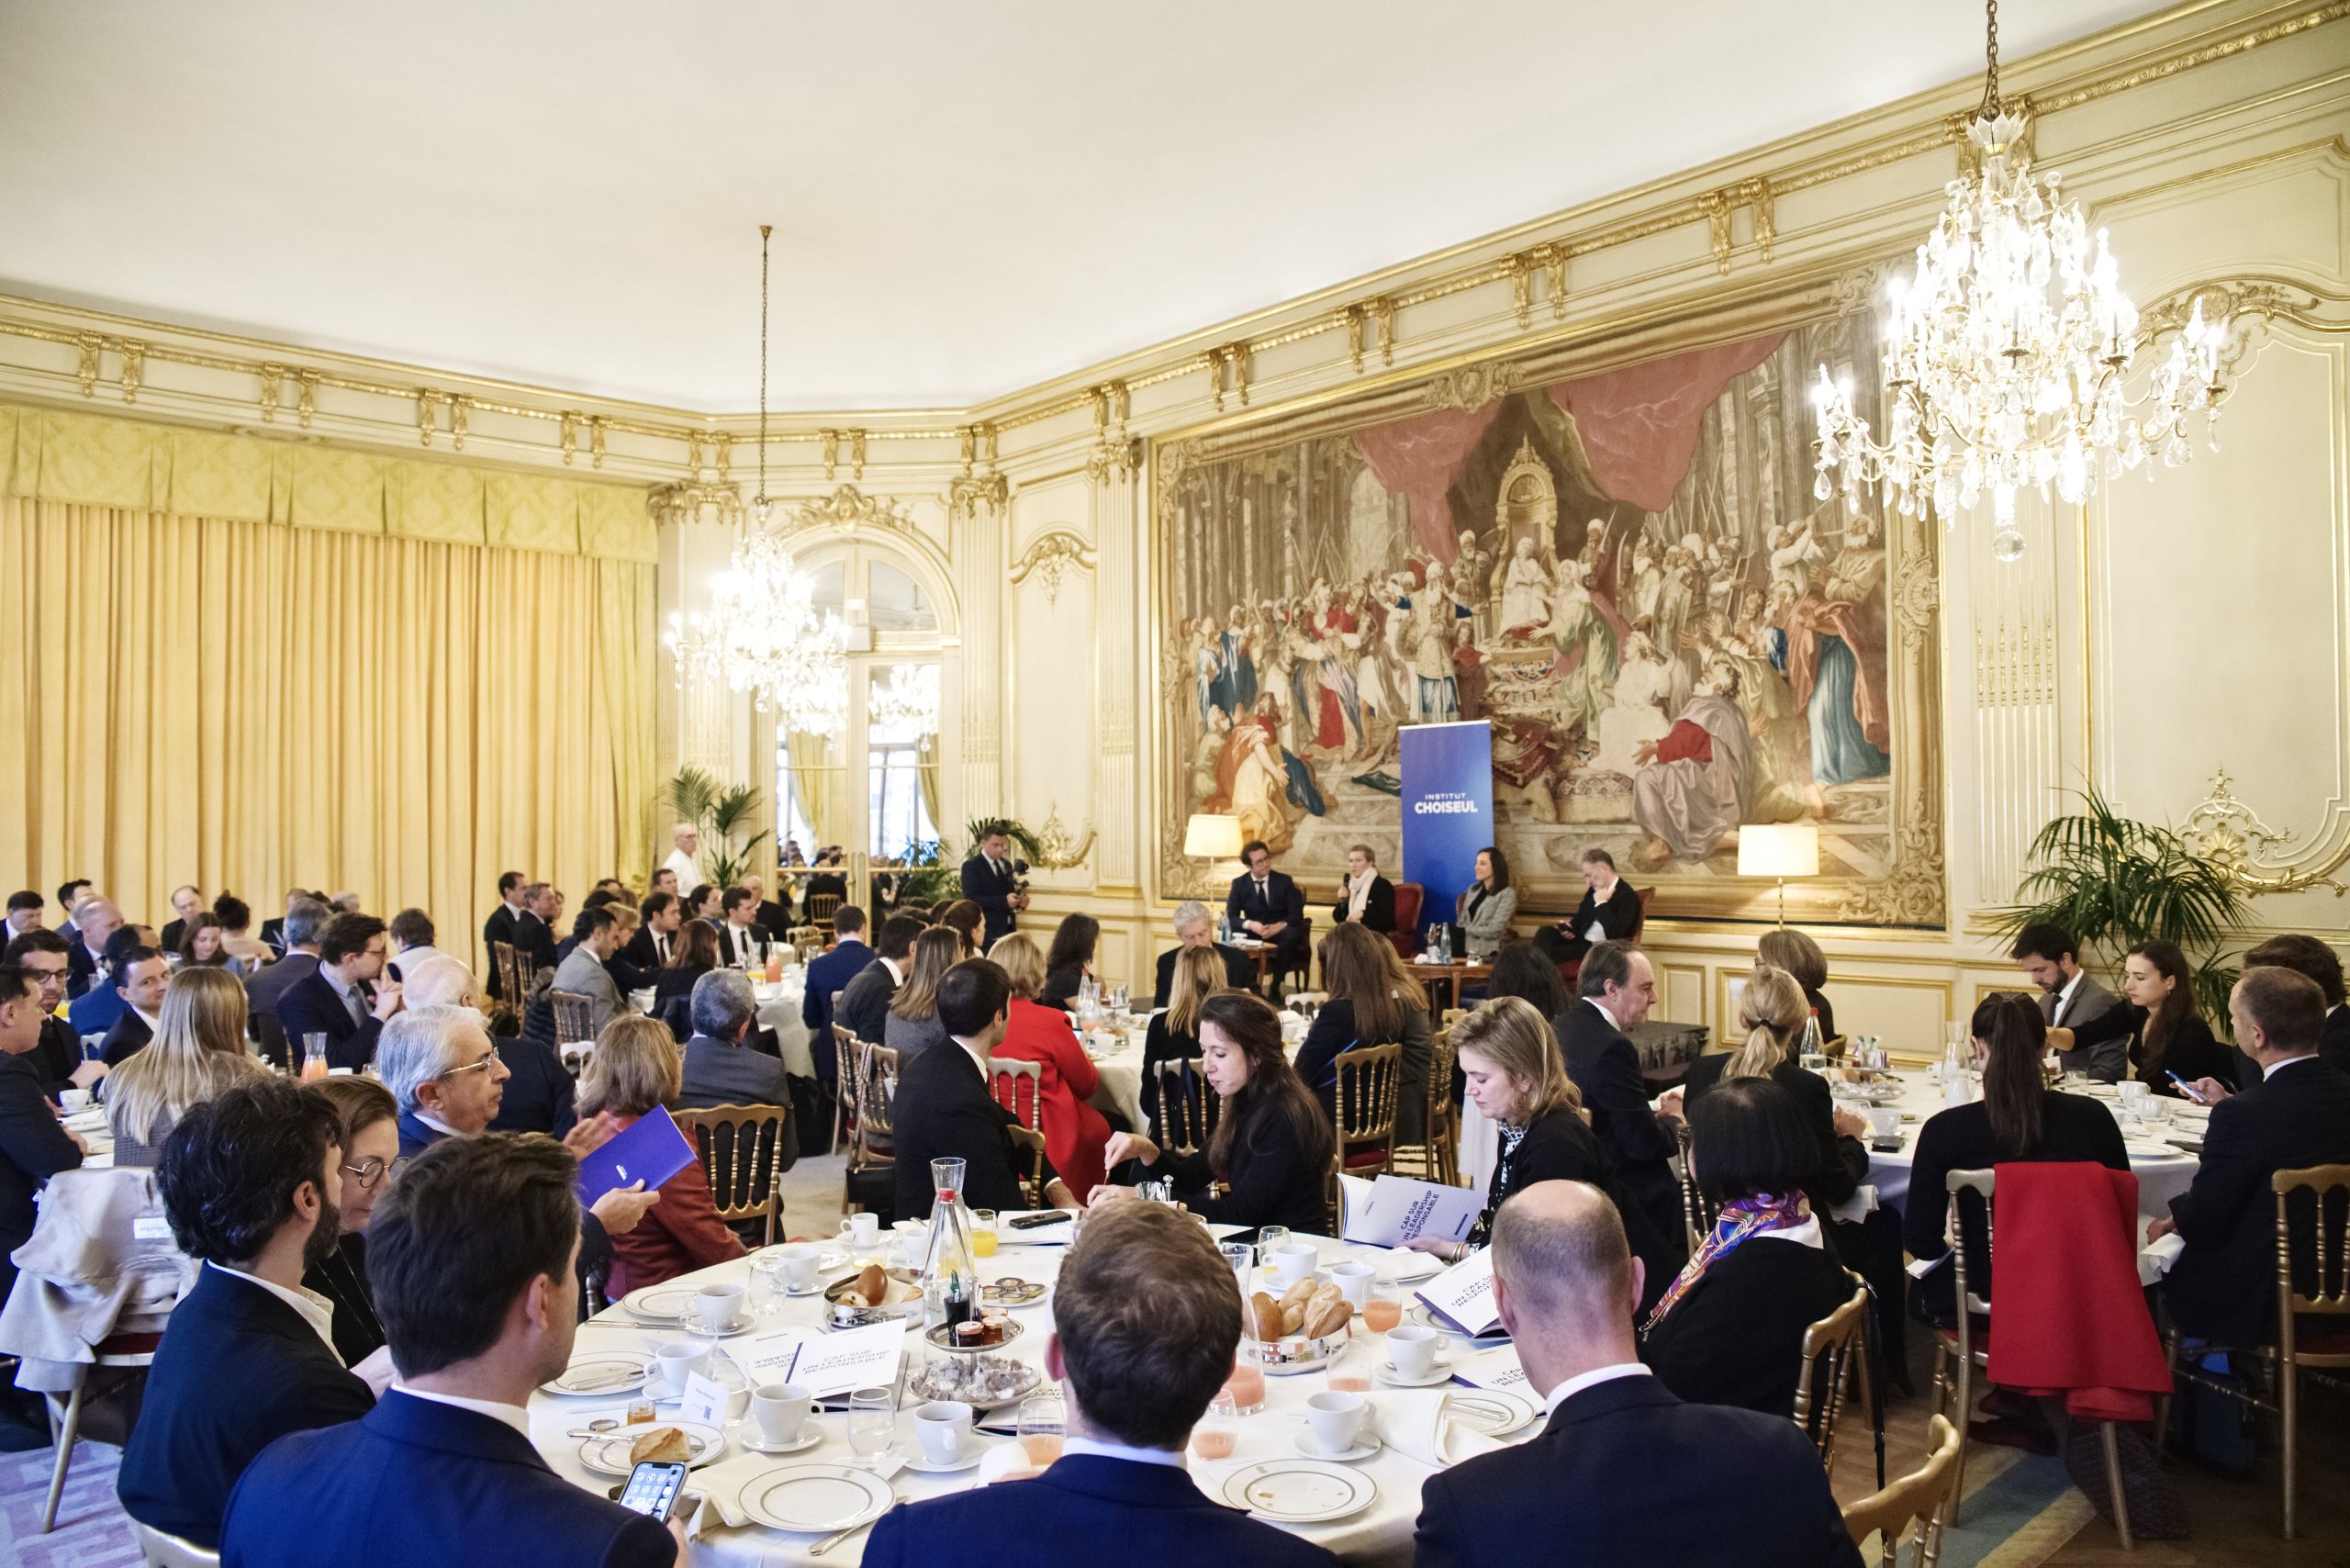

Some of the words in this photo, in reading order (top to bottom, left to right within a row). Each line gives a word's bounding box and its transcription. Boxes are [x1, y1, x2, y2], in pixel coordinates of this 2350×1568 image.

[1425, 792, 1467, 801] INSTITUT
[1415, 801, 1479, 813] CHOISEUL
[1400, 1215, 1411, 1230] CAP
[1408, 1201, 1420, 1215] SUR
[1407, 1190, 1433, 1231] LEADERSHIP
[1463, 1281, 1481, 1293] CAP
[1451, 1295, 1465, 1305] UN
[803, 1362, 819, 1371] UN
[822, 1350, 891, 1366] LEADERSHIP
[804, 1355, 885, 1374] RESPONSABLE
